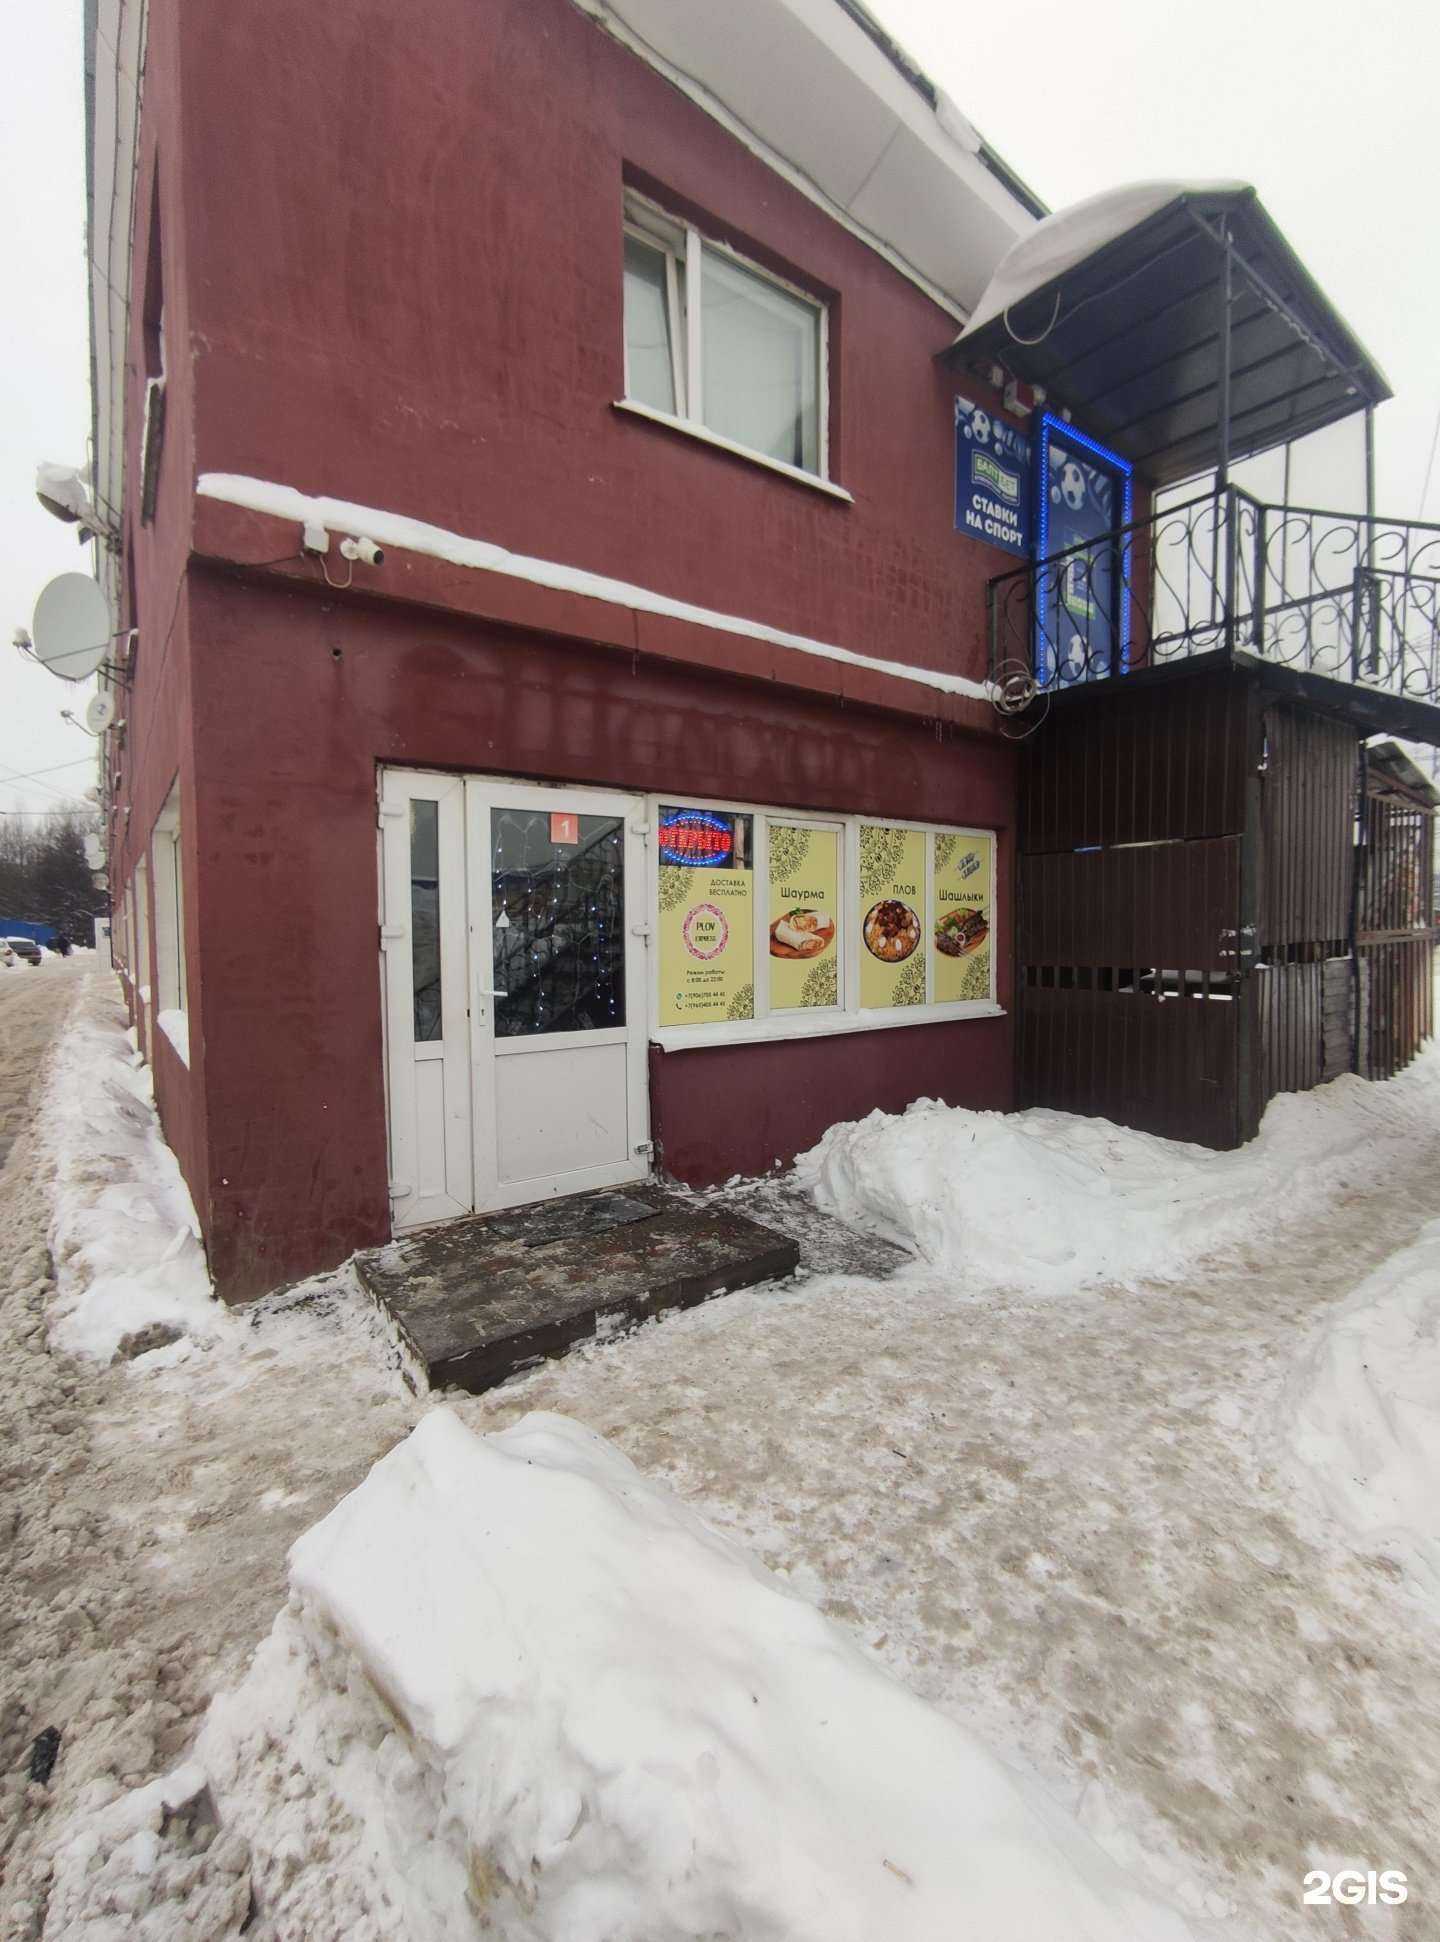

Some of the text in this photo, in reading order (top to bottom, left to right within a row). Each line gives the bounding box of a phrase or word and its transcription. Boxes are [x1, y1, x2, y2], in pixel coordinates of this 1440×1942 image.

[972, 494, 1018, 527] СТАВКИ
[965, 510, 1023, 547] НА СПОРТ
[561, 819, 569, 838] 1
[710, 879, 746, 887] ДОСТАВКА
[893, 884, 916, 896] ПЛОВ
[709, 889, 748, 897] БЕСПЛАТНО
[781, 887, 825, 901] Шаурма
[939, 888, 984, 902] Шашлыки
[696, 921, 716, 931] PLOV
